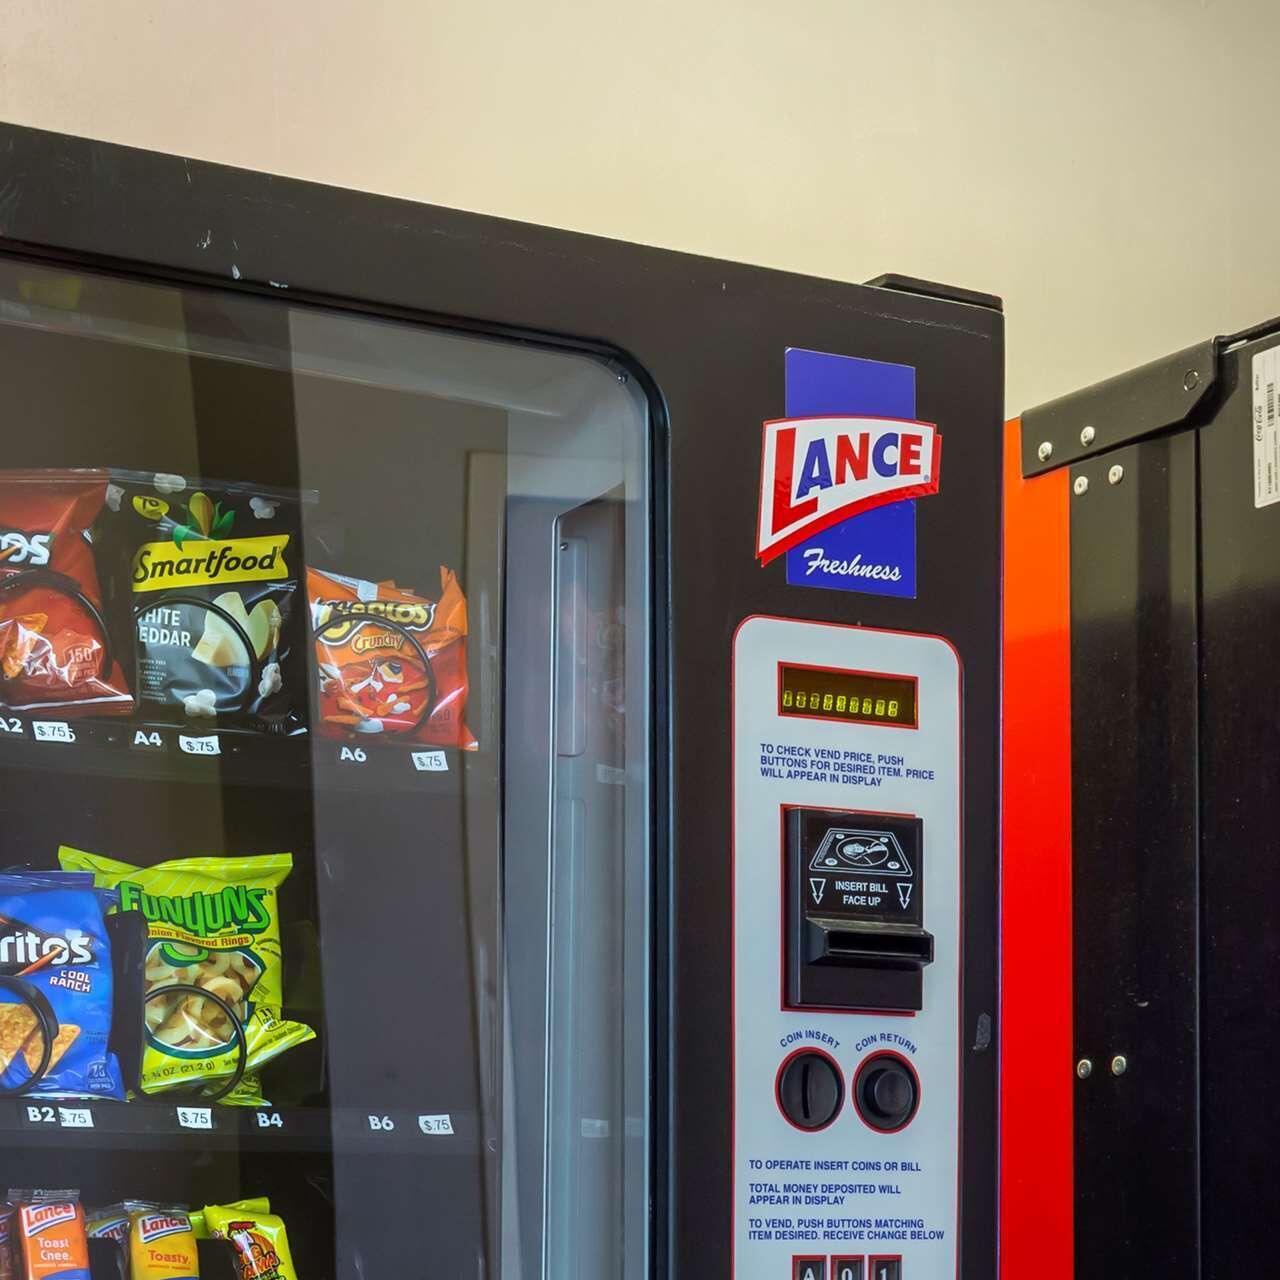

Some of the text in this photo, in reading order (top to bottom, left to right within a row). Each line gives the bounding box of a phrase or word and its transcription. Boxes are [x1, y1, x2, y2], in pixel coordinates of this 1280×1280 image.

[771, 428, 922, 536] LANCE
[133, 546, 278, 583] Smartfood
[804, 548, 902, 581] Freshness
[36, 725, 67, 738] $.75
[134, 730, 163, 746] A4
[185, 740, 215, 752] $.75
[341, 747, 367, 762] A6
[760, 744, 904, 765] TO CHECK VEND PRICE, PUSH
[761, 756, 934, 780] BUTTONS FOR DESIRED ITEM. PRICE
[761, 768, 882, 786] WILL APPEAR IN DISPLAY
[835, 881, 888, 893] INSERT BILL
[843, 896, 881, 905] FACE UP
[121, 881, 271, 937] FUNYUNS
[221, 932, 250, 945] Rings
[60, 970, 90, 983] COOL
[50, 976, 91, 992] RANCH
[780, 1030, 840, 1049] COIN INSERT
[856, 1033, 917, 1054] COIN RETURN
[27, 1107, 55, 1121] B2
[181, 1111, 208, 1124] $.75
[257, 1114, 283, 1127] B4
[369, 1116, 394, 1130] B6
[424, 1119, 449, 1131] $.75
[749, 1160, 921, 1172] TO OPERATE INSERT COINS OR BILL
[749, 1184, 901, 1194] TOTAL MONEY DEPOSITED WILL
[749, 1196, 845, 1205] APPEAR IN DISPLAY
[26, 1204, 73, 1226] Lance
[142, 1217, 187, 1234] Lance
[749, 1219, 924, 1229] TO VEND, PUSH BUTTONS MATCHING
[749, 1231, 944, 1240] ITEM DESIRED. RECEIVE CHANGE BELOW
[37, 1238, 69, 1248] Toast
[148, 1250, 188, 1264] Toasty
